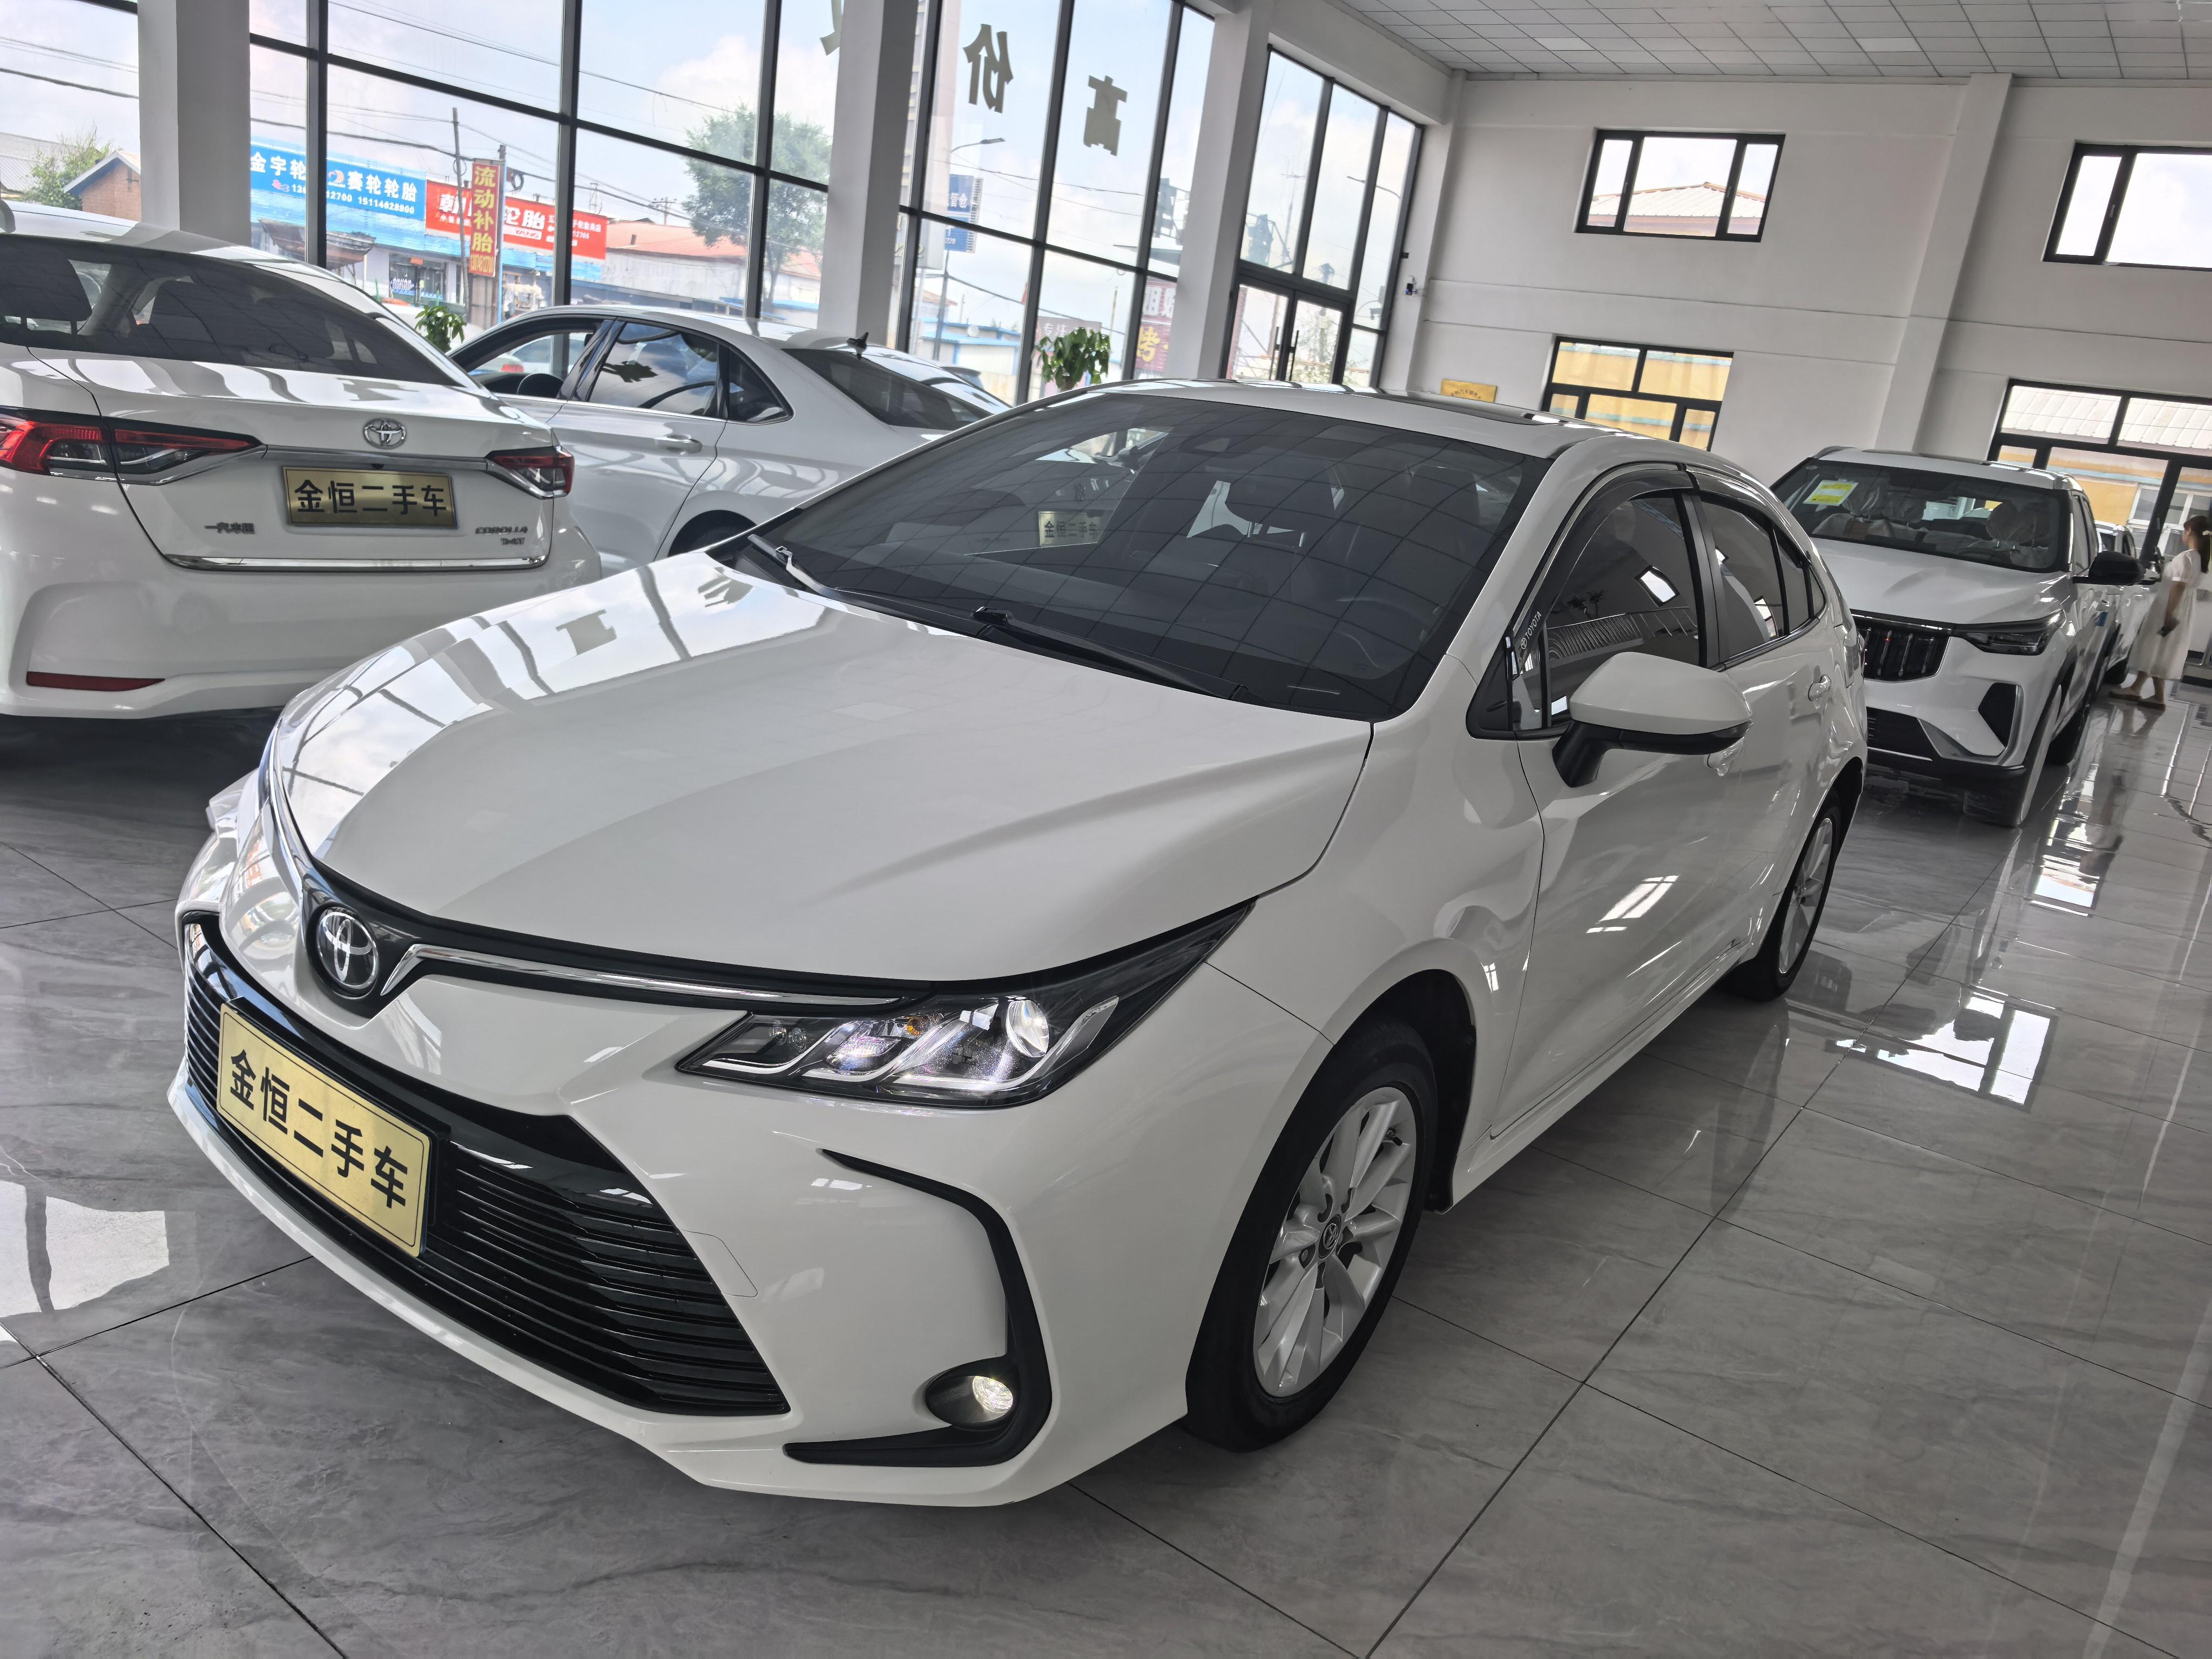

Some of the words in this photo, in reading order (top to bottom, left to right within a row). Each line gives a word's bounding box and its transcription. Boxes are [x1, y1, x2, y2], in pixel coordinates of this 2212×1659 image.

[347, 170, 417, 203] 赛轮轮胎
[471, 166, 496, 253] 流动补胎
[294, 480, 447, 516] 金恒二手车
[475, 526, 528, 534] COROLLA
[1044, 520, 1098, 539] 金恒二手车
[1525, 611, 1542, 640] TOYOTA
[230, 1049, 408, 1209] 金恒二手车
